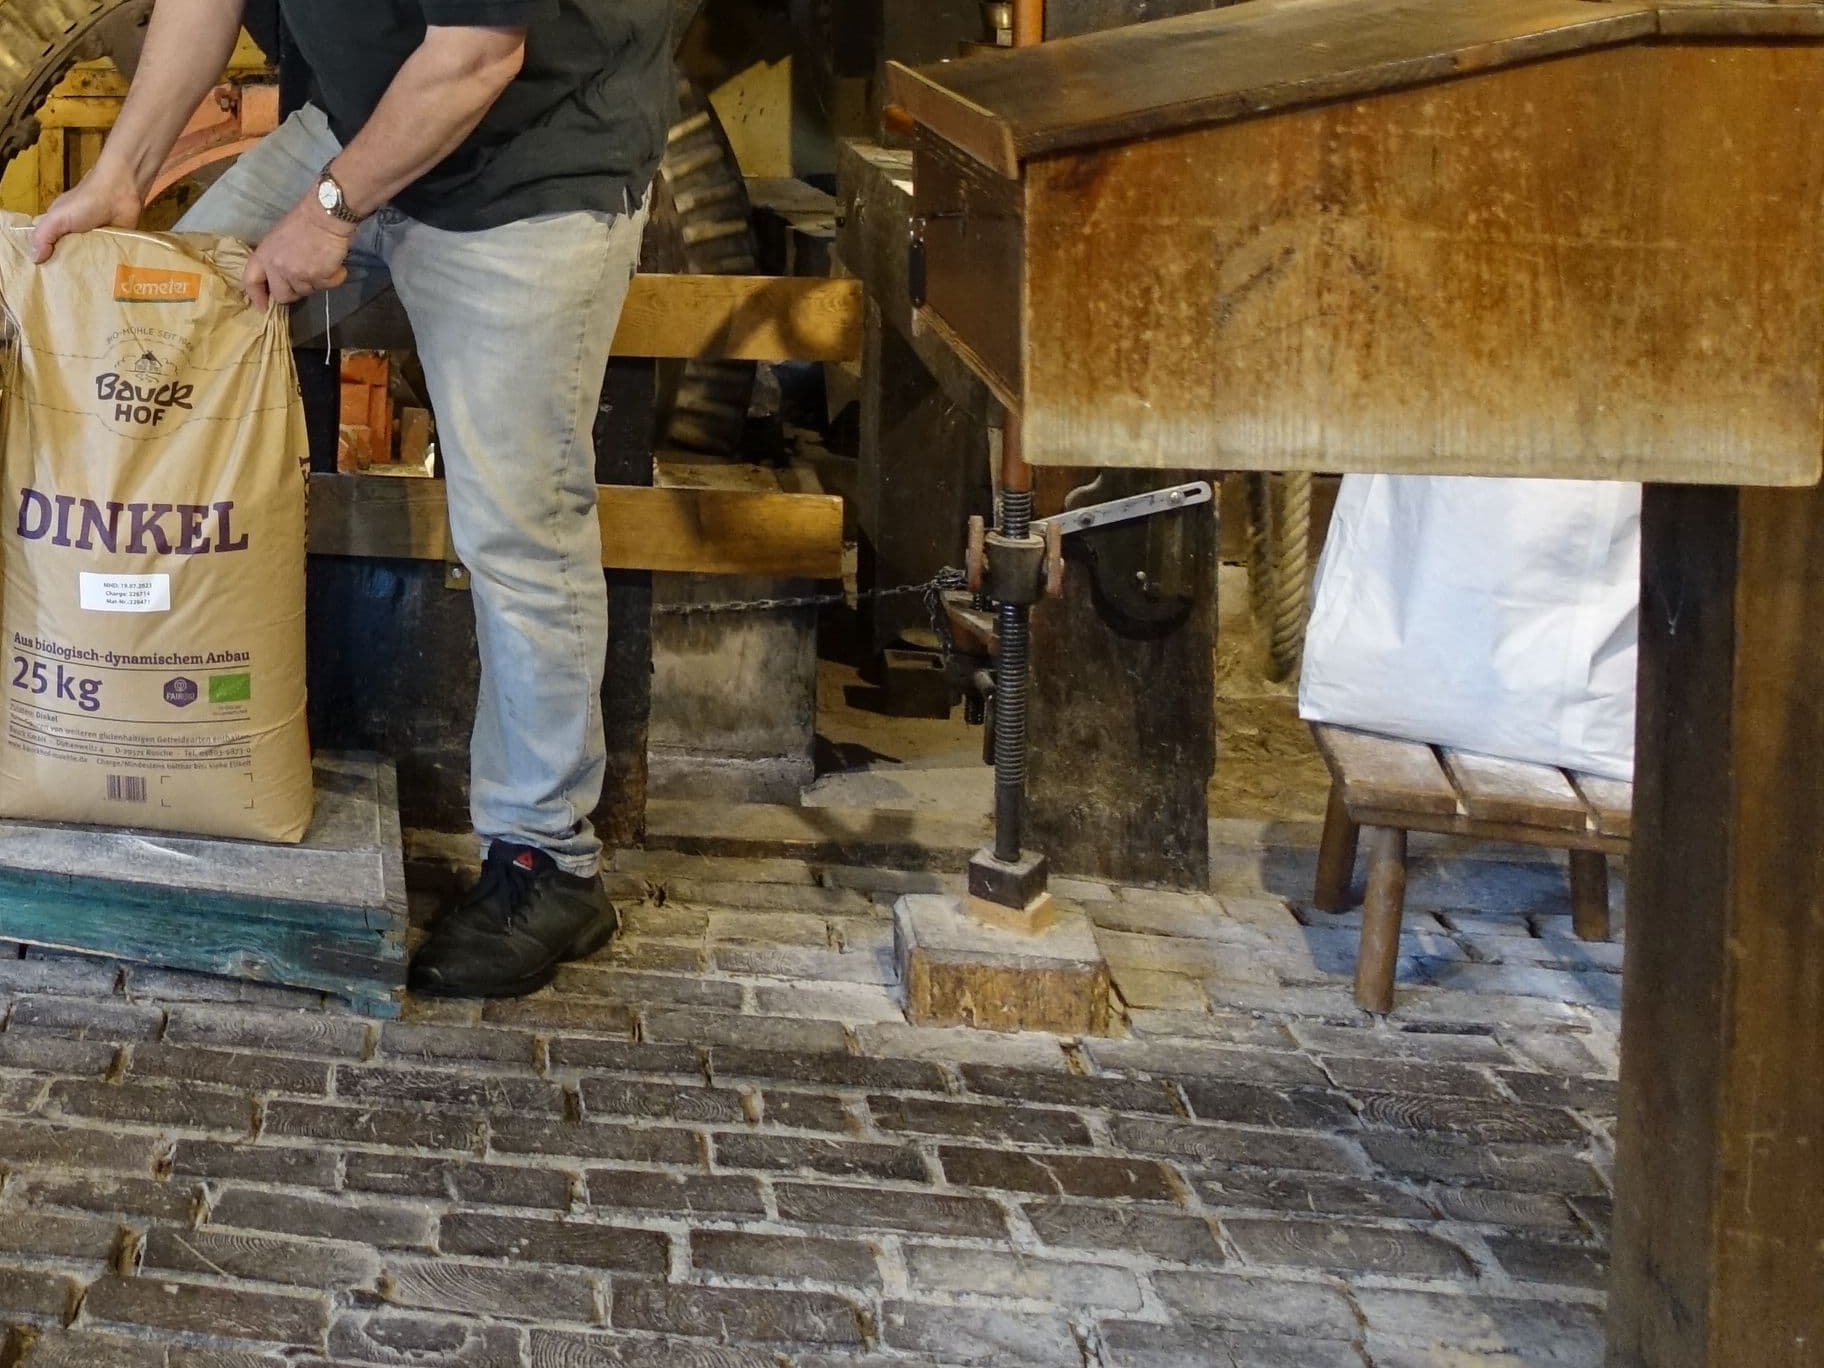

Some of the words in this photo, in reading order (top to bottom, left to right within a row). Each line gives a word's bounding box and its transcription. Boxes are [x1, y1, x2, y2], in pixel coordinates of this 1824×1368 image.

[120, 273, 188, 295] demeter
[95, 372, 194, 410] Bauck
[114, 404, 166, 427] HOF
[16, 486, 250, 556] DINKEL
[14, 631, 34, 649] Aus
[34, 638, 204, 666] biologisch-dynamischem
[206, 649, 250, 665] Anbau
[12, 655, 48, 695] 25
[56, 664, 103, 712] kg
[36, 712, 58, 723] Dinkel
